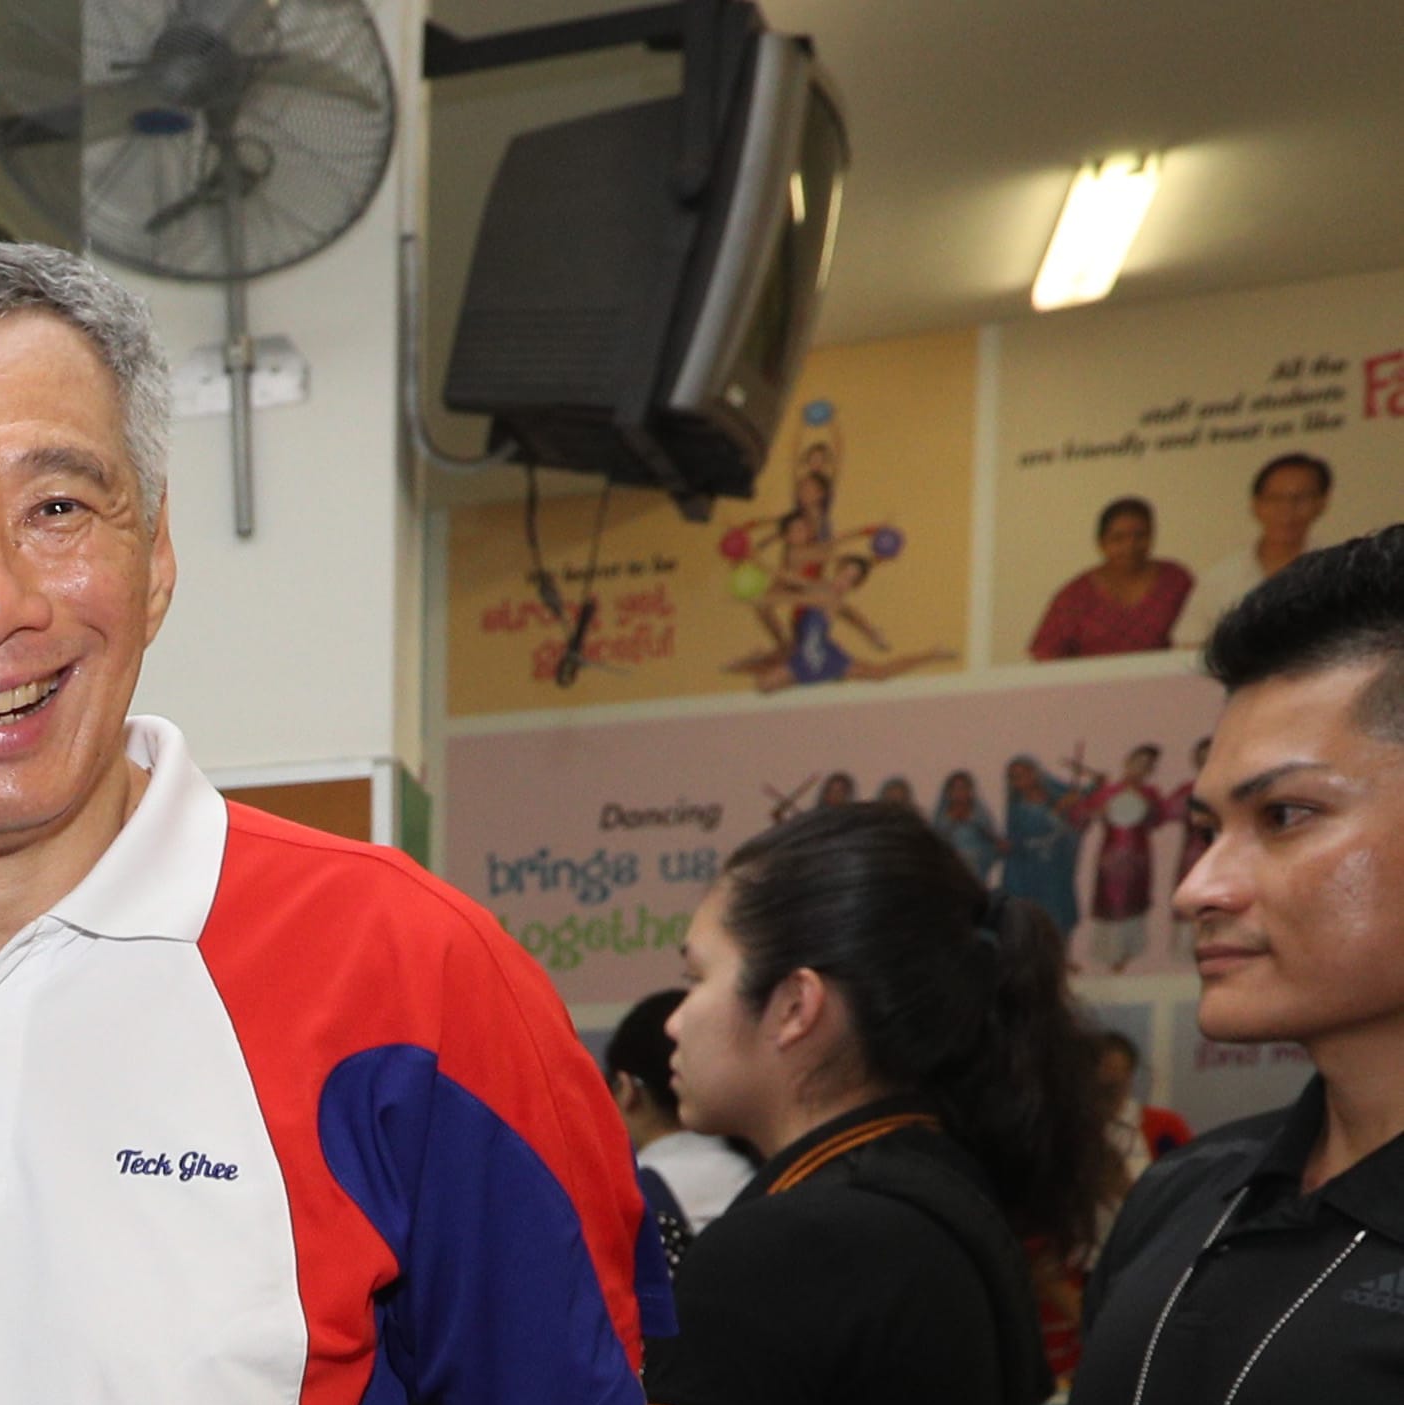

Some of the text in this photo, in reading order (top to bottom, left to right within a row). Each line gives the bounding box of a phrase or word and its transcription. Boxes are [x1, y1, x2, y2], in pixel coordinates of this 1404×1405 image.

[598, 801, 723, 831] Dancing
[486, 847, 717, 905] brings us
[498, 904, 693, 971] ogethe
[116, 1149, 239, 1182] Teck Ghee
